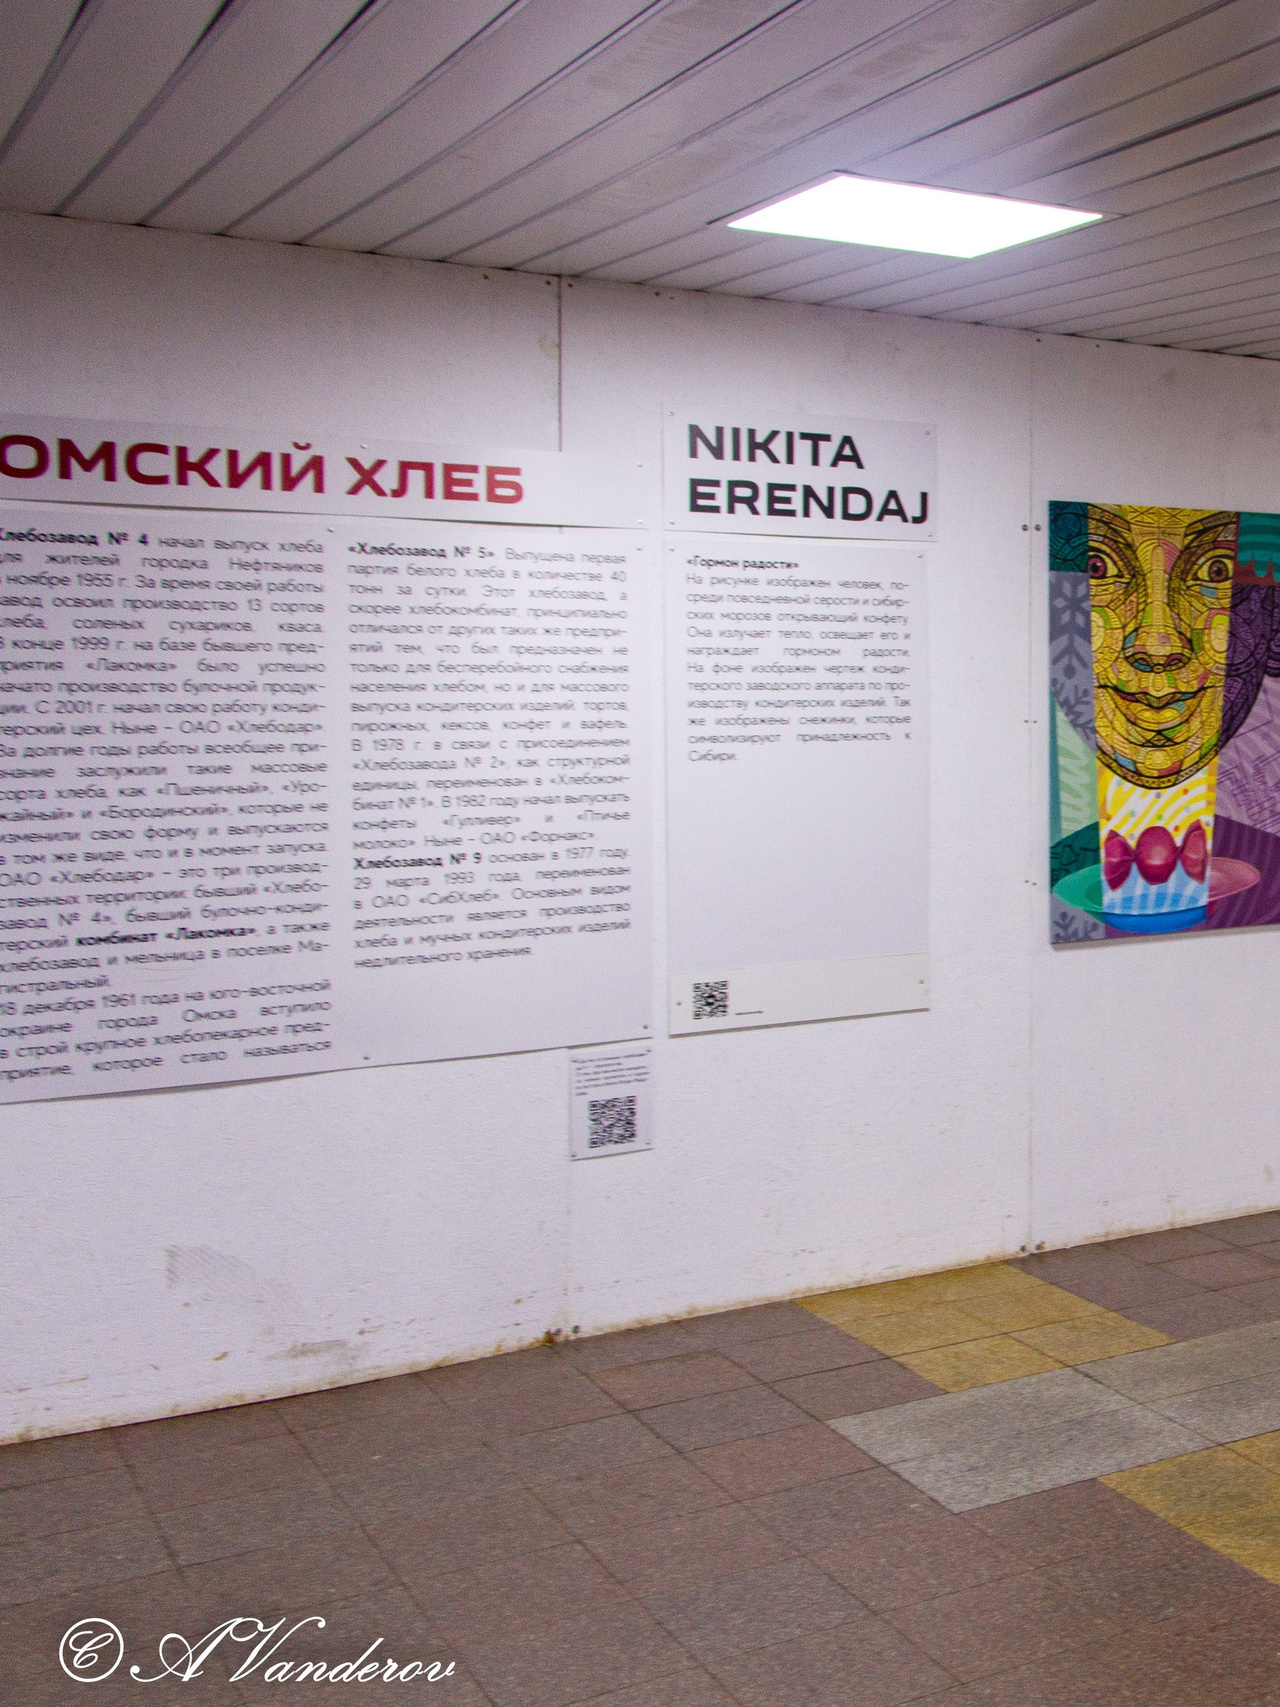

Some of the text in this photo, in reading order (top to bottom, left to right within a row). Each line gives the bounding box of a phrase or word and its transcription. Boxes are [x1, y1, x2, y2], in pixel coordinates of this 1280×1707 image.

[687, 423, 865, 469] NIKITA
[0, 434, 525, 505] ОМСКИЙ ХЛЕБ
[689, 478, 929, 524] ERENDAJ
[348, 542, 446, 559] «Хлебозавод
[686, 555, 799, 572] «Гормон радости»
[353, 855, 443, 870] Хлебозавод
